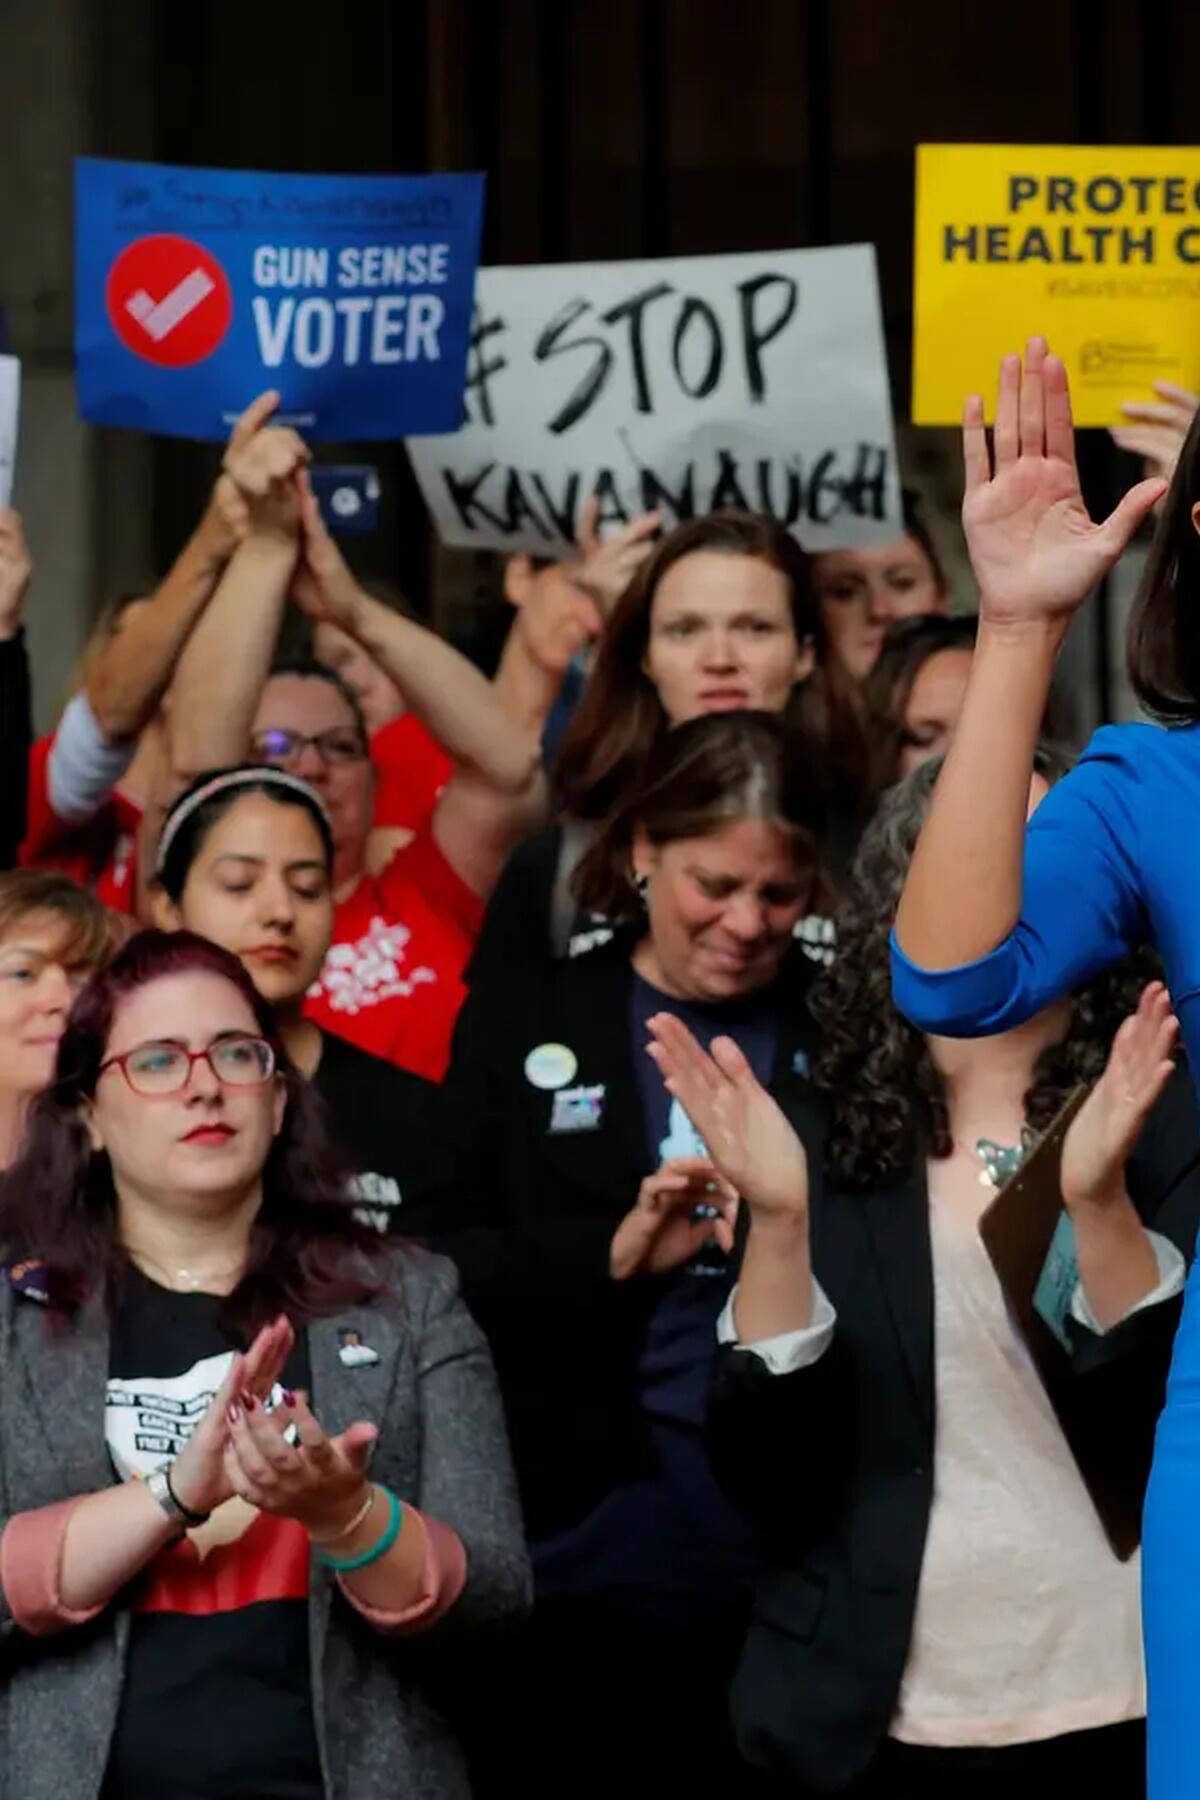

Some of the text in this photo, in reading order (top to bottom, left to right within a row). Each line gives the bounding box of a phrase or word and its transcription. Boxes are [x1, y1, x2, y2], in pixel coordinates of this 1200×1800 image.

[253, 243, 450, 289] GUN SENSE
[942, 223, 1156, 264] HEALTH
[252, 293, 445, 369] VOTER
